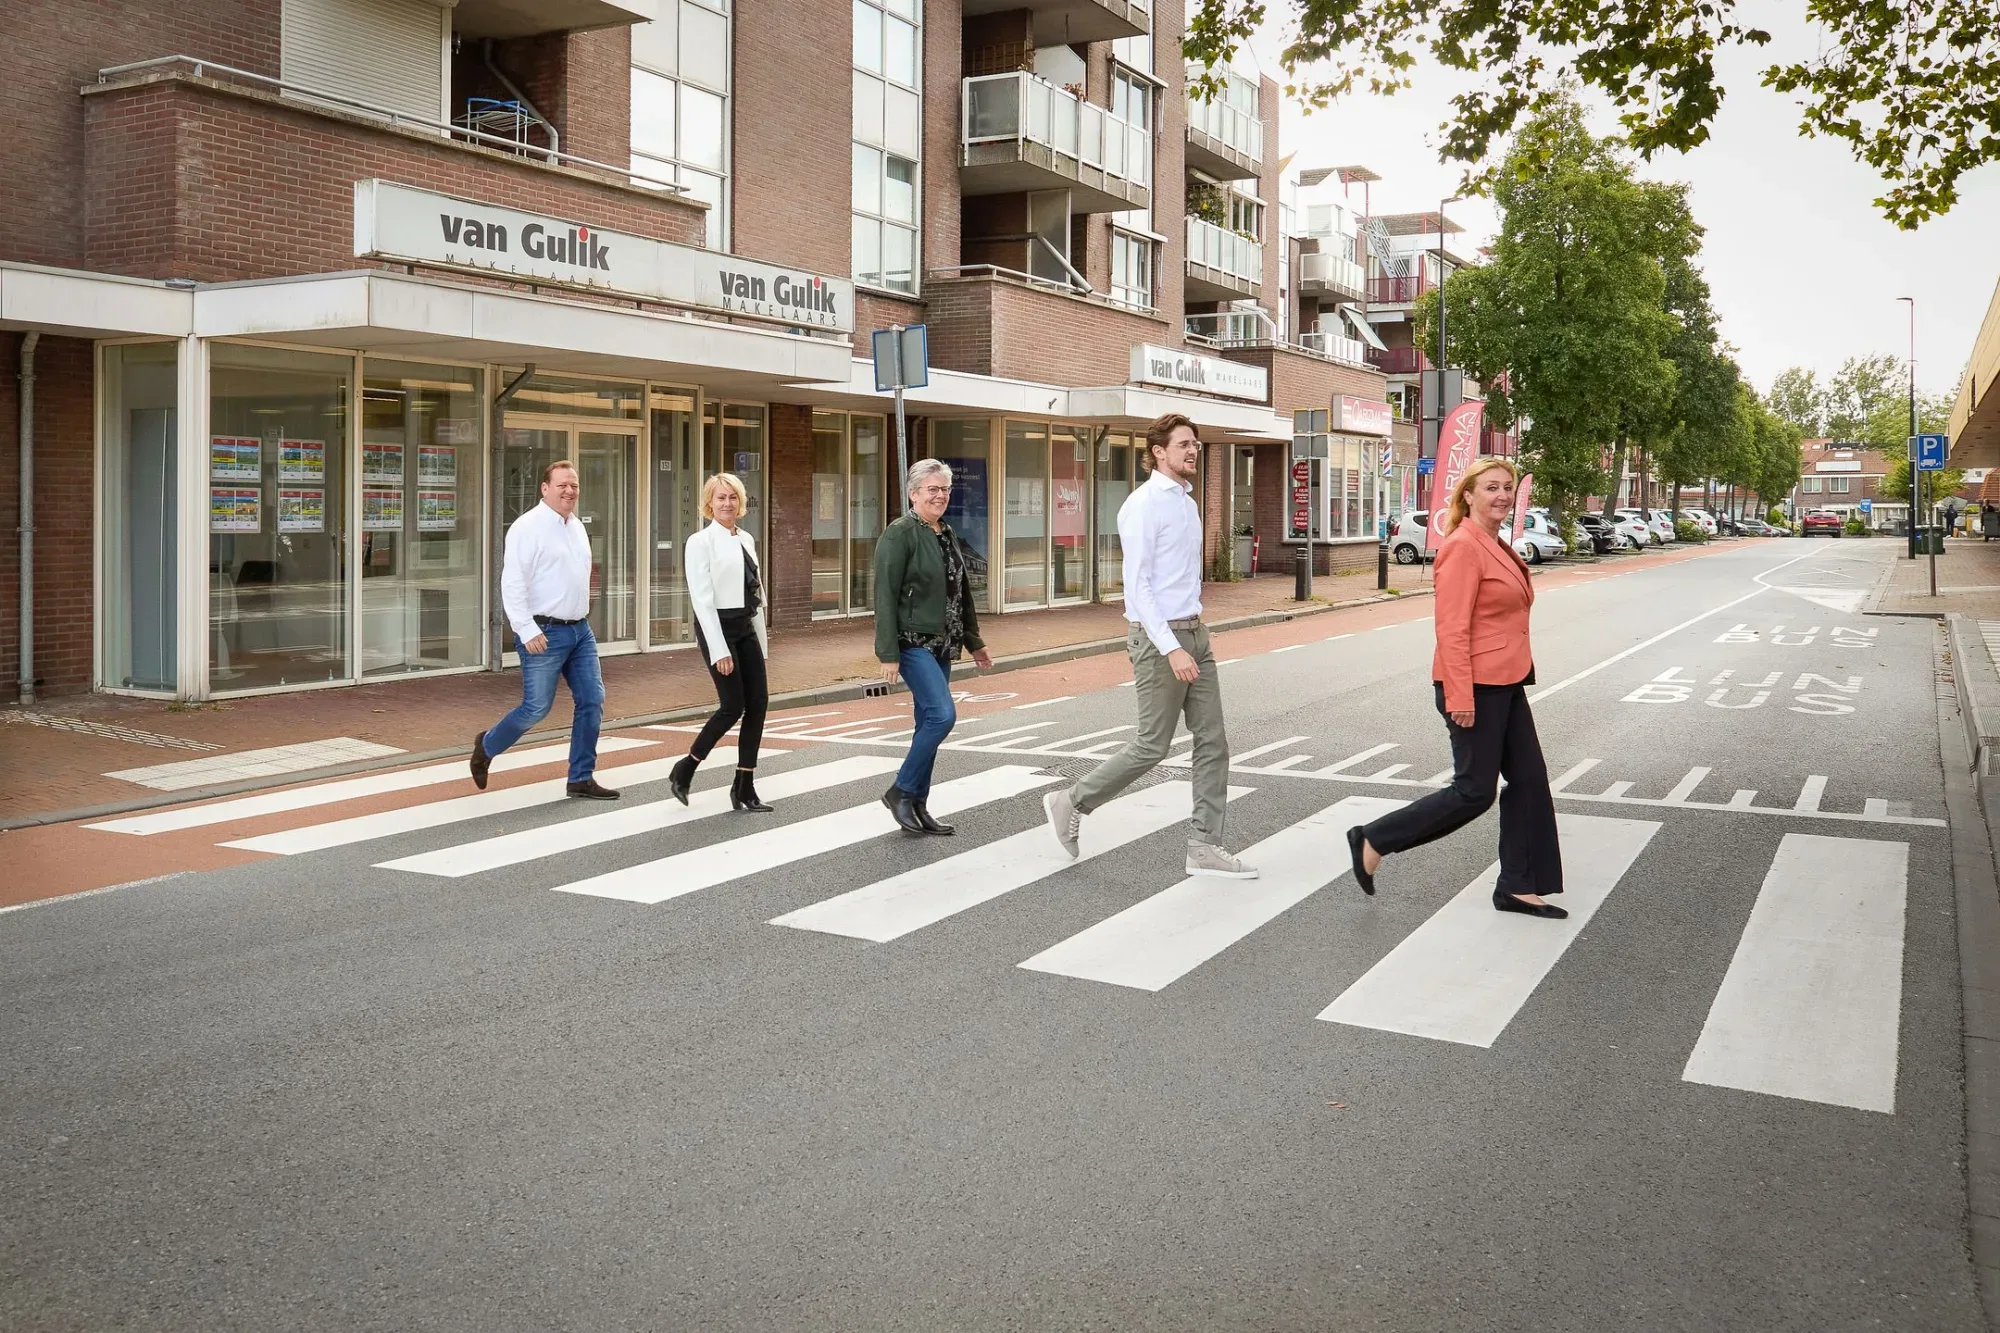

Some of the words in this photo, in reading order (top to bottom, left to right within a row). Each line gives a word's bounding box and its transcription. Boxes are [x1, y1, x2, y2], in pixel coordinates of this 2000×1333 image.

[440, 214, 507, 252] van
[521, 223, 610, 271] Gulik
[446, 253, 612, 289] MAKELAARS
[719, 270, 766, 301] van
[773, 275, 836, 314] Gulik
[723, 297, 837, 327] MAKELAARS
[1151, 359, 1172, 379] van
[1176, 358, 1205, 385] Gulik
[1923, 437, 1938, 456] P
[1712, 632, 1869, 648] BUS
[1728, 623, 1879, 637] LIJN
[1651, 666, 1864, 693] LIJN
[1618, 683, 1856, 715] BUS
